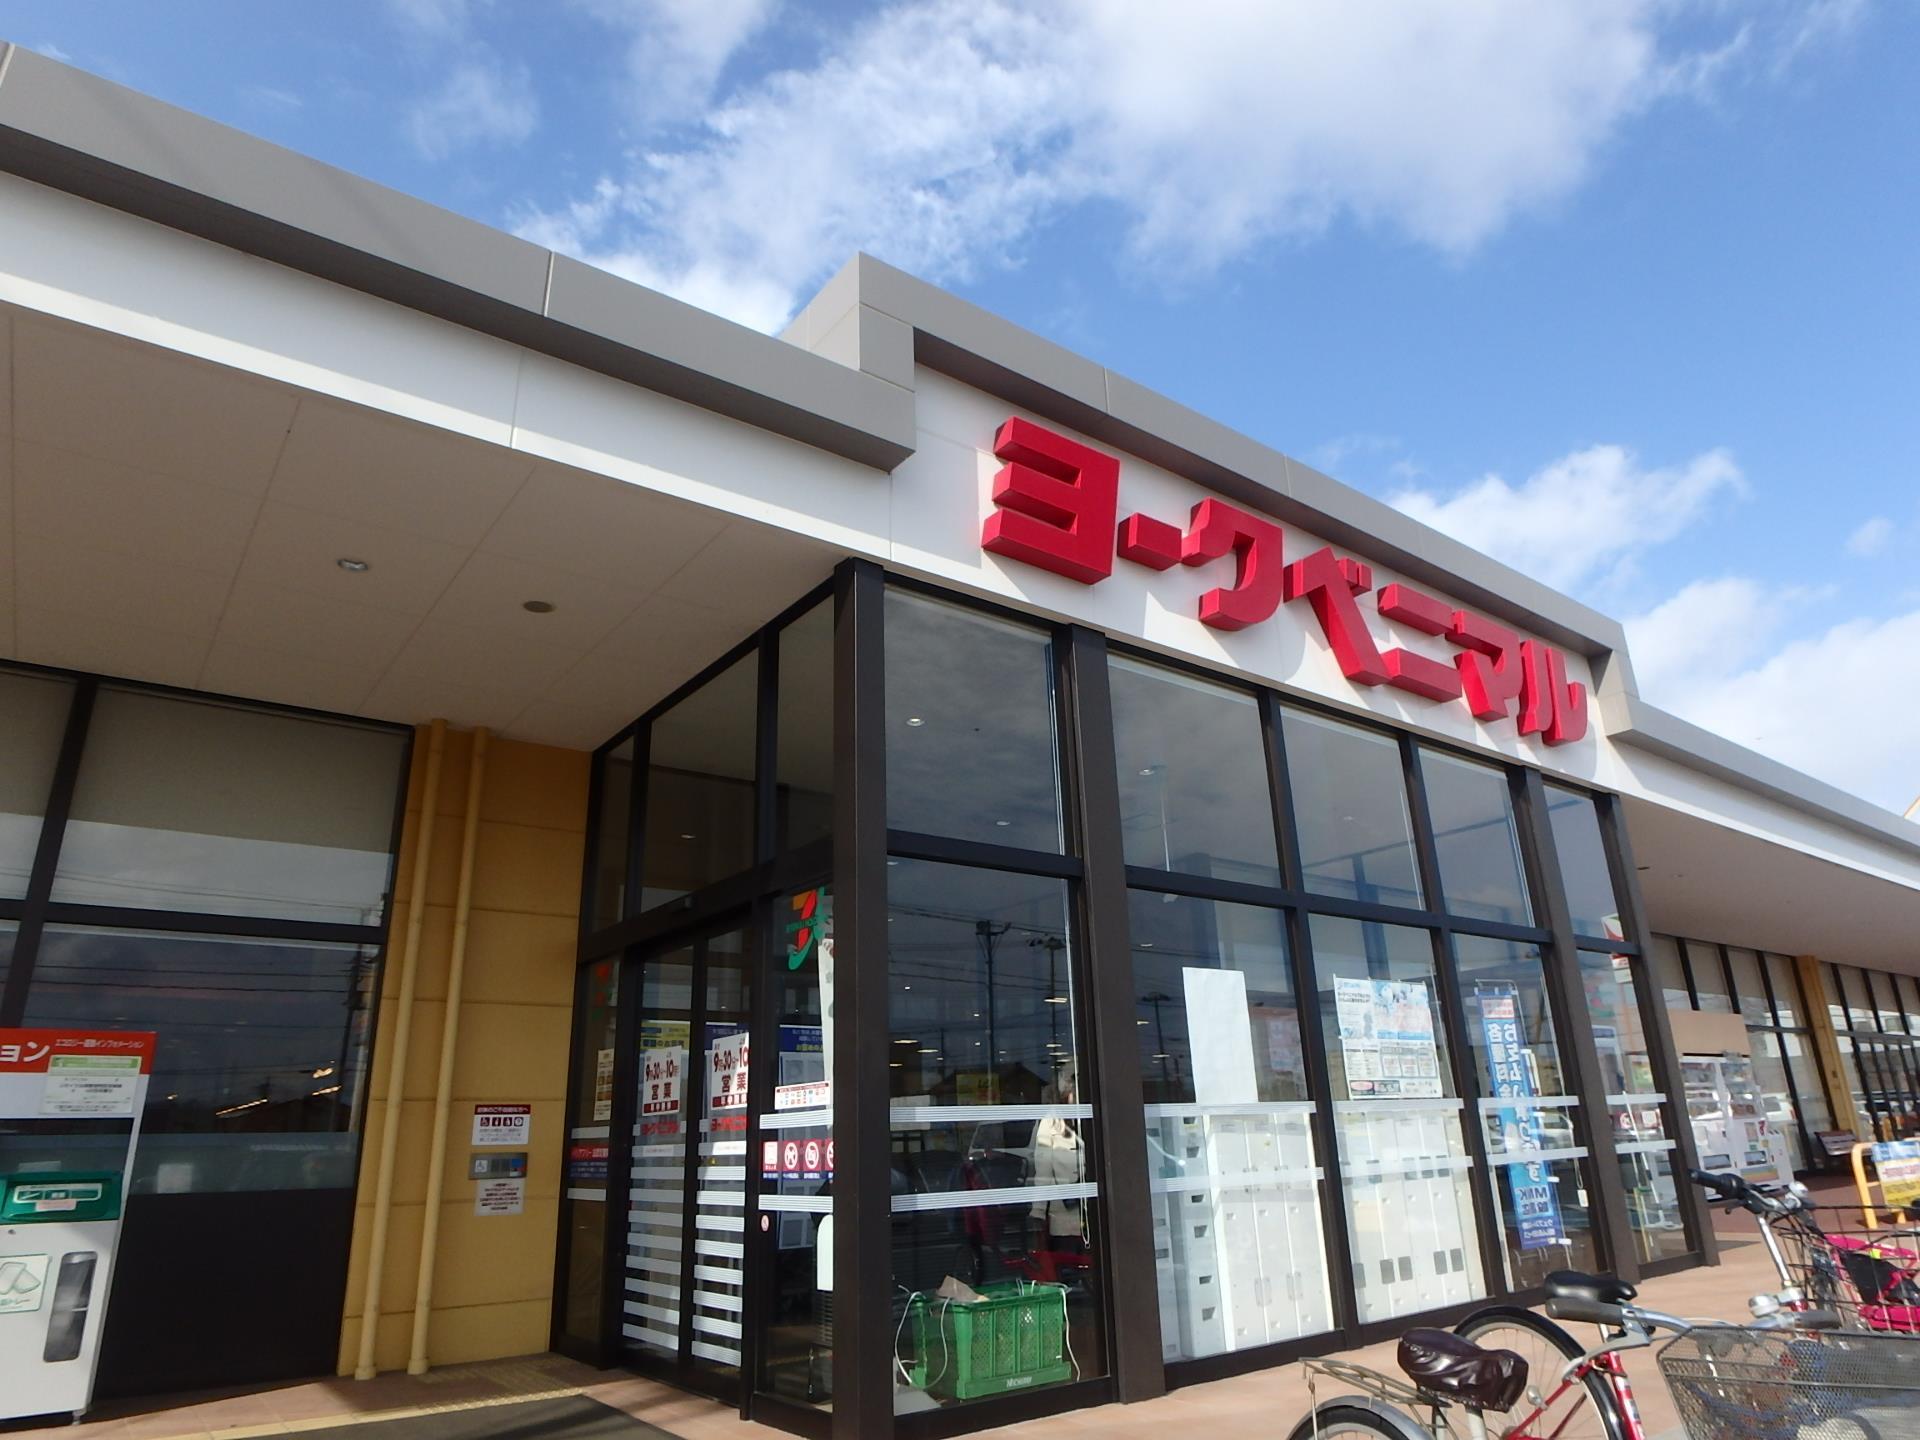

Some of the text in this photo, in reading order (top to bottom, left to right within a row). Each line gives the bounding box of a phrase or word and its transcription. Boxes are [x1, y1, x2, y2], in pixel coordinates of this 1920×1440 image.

[981, 415, 1588, 747] ヨークベニマル
